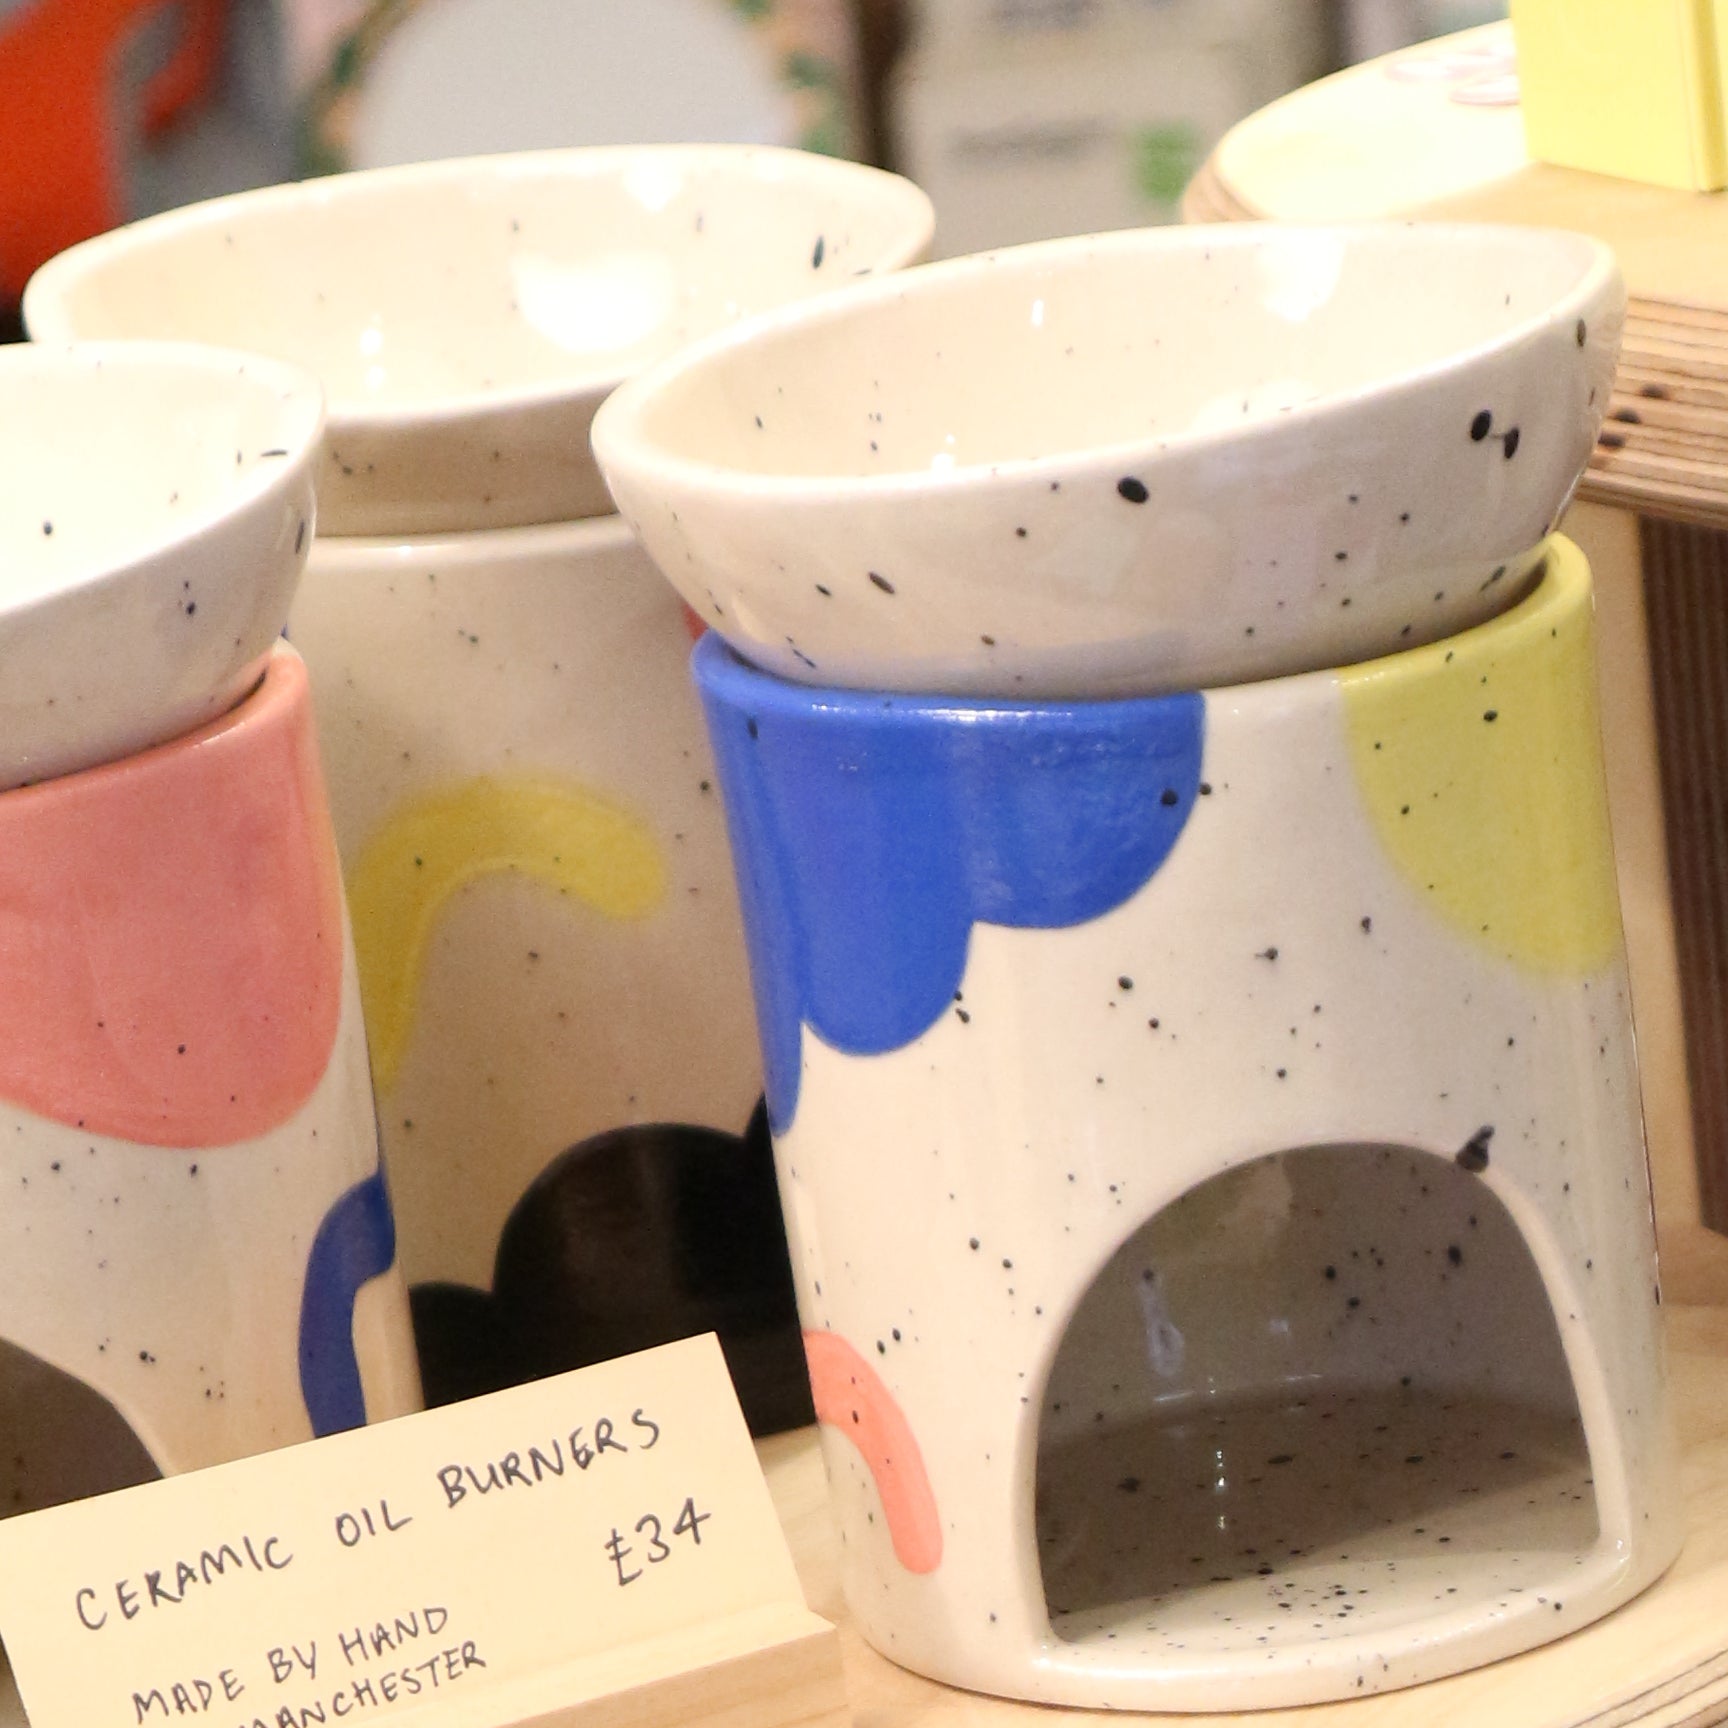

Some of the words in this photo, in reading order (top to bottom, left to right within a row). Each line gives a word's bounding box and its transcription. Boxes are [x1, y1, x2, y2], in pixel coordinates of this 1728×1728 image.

[74, 1534, 294, 1631] CERAMIC
[334, 1504, 414, 1549] OIL
[436, 1408, 662, 1510] BURNERS
[605, 1497, 713, 1588] £34
[132, 1668, 245, 1726] MADE
[267, 1635, 319, 1687] BY
[339, 1605, 449, 1668] HAND
